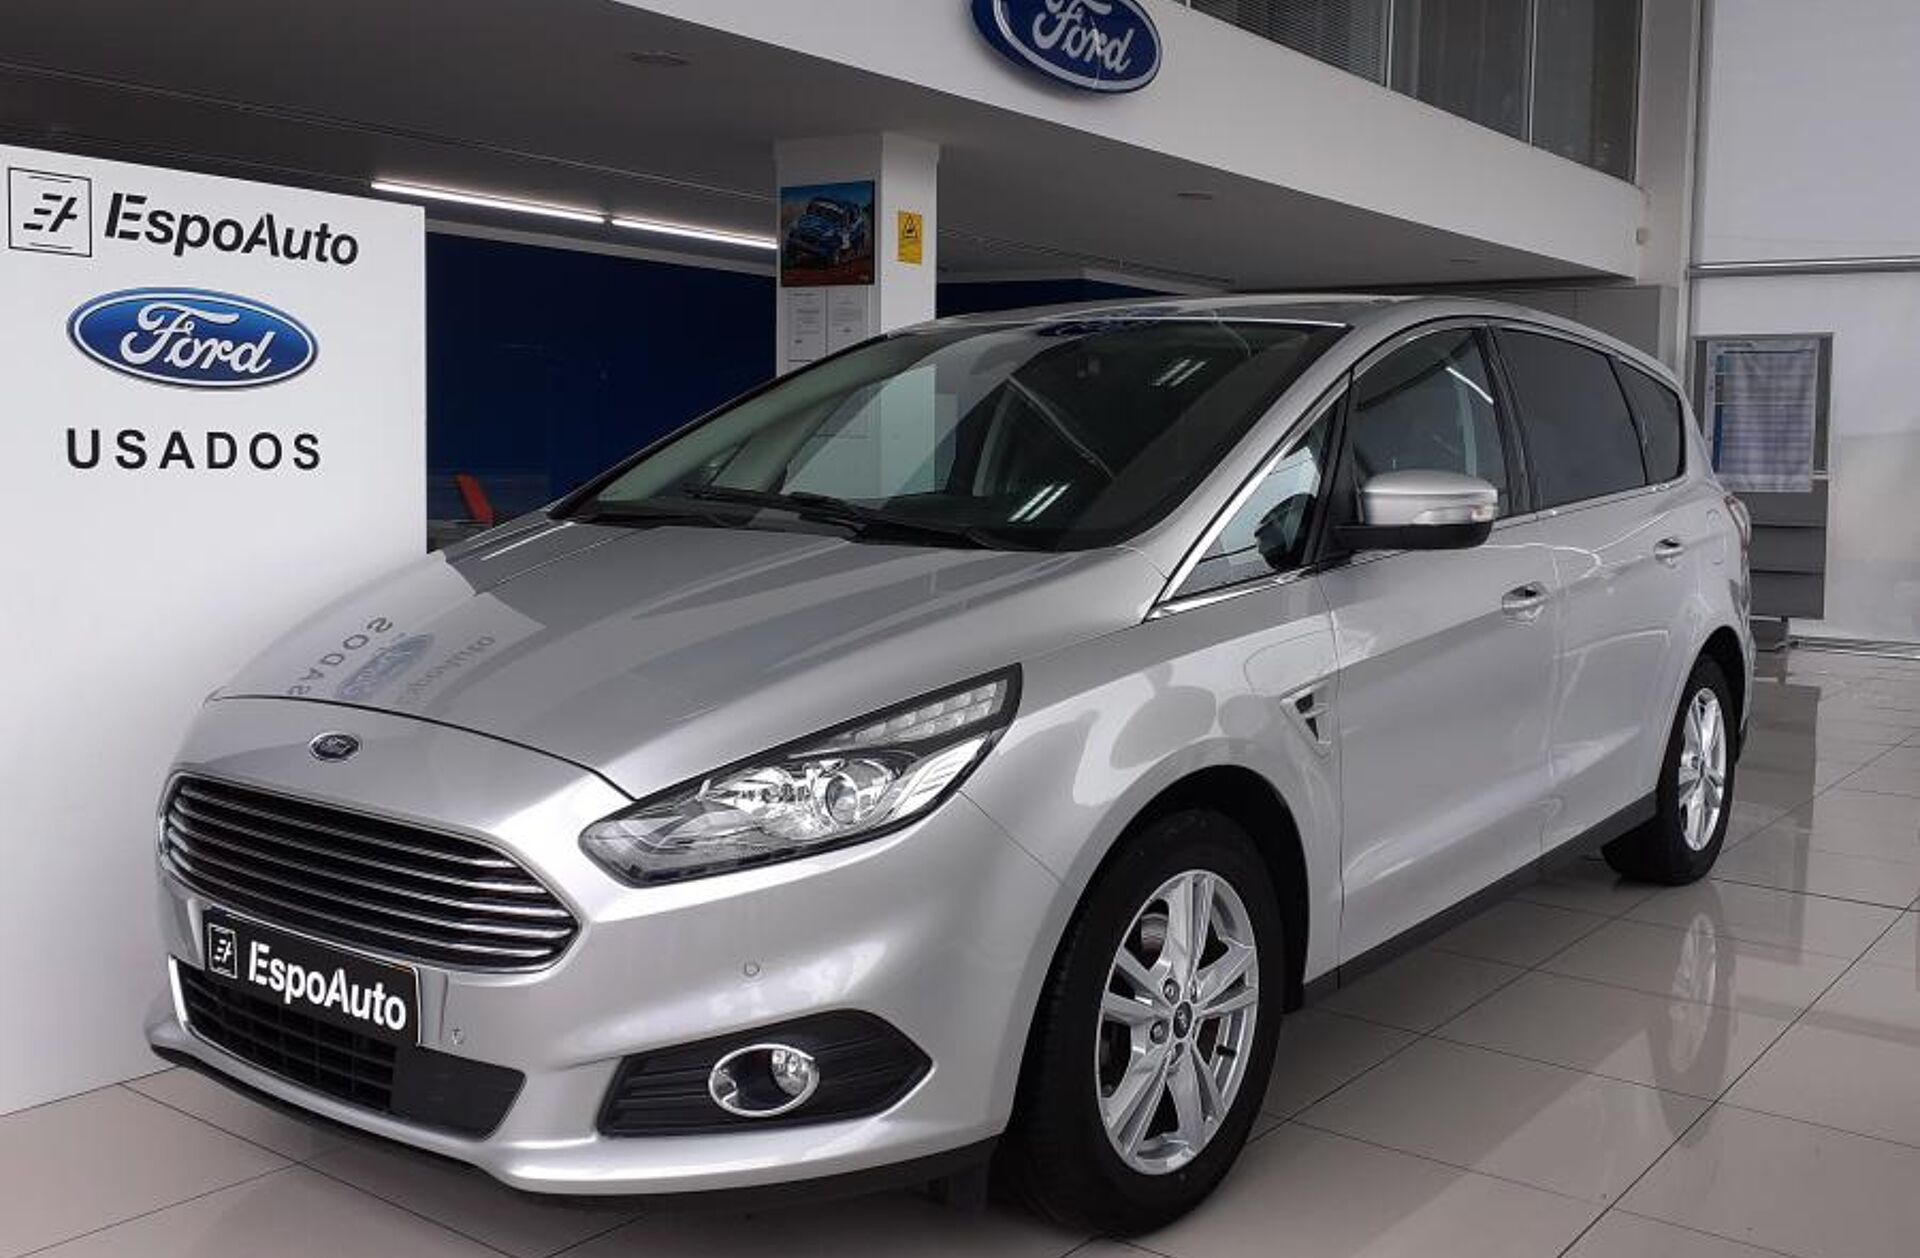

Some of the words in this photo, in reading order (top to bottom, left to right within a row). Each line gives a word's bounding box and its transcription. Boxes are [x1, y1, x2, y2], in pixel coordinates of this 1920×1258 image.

[1032, 0, 1134, 74] Ford
[105, 192, 359, 265] EspoAuto
[120, 303, 274, 374] Ford
[66, 428, 320, 471] USADOS
[249, 941, 406, 1031] EspoAuto
